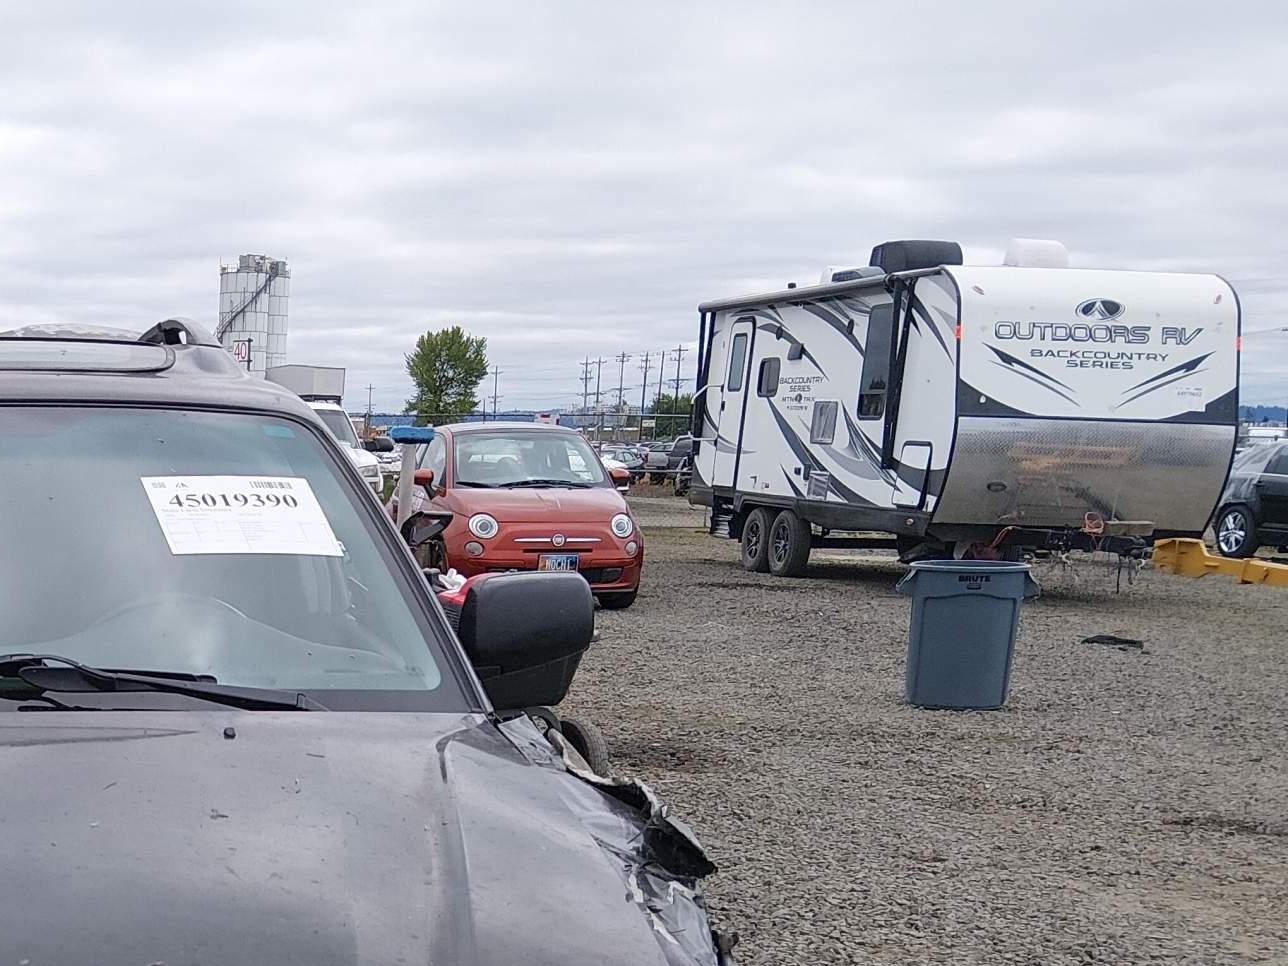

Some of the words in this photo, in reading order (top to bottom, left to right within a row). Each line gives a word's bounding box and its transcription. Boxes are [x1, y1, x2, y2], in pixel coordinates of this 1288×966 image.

[994, 321, 1152, 345] OUTDOORS
[1161, 327, 1205, 346] RV
[233, 342, 247, 360] 40
[1030, 349, 1169, 362] BACKCOUNTRY
[1065, 360, 1134, 370] SERIES
[779, 376, 824, 384] BACKCOUNTRY
[169, 493, 298, 508] 45019390
